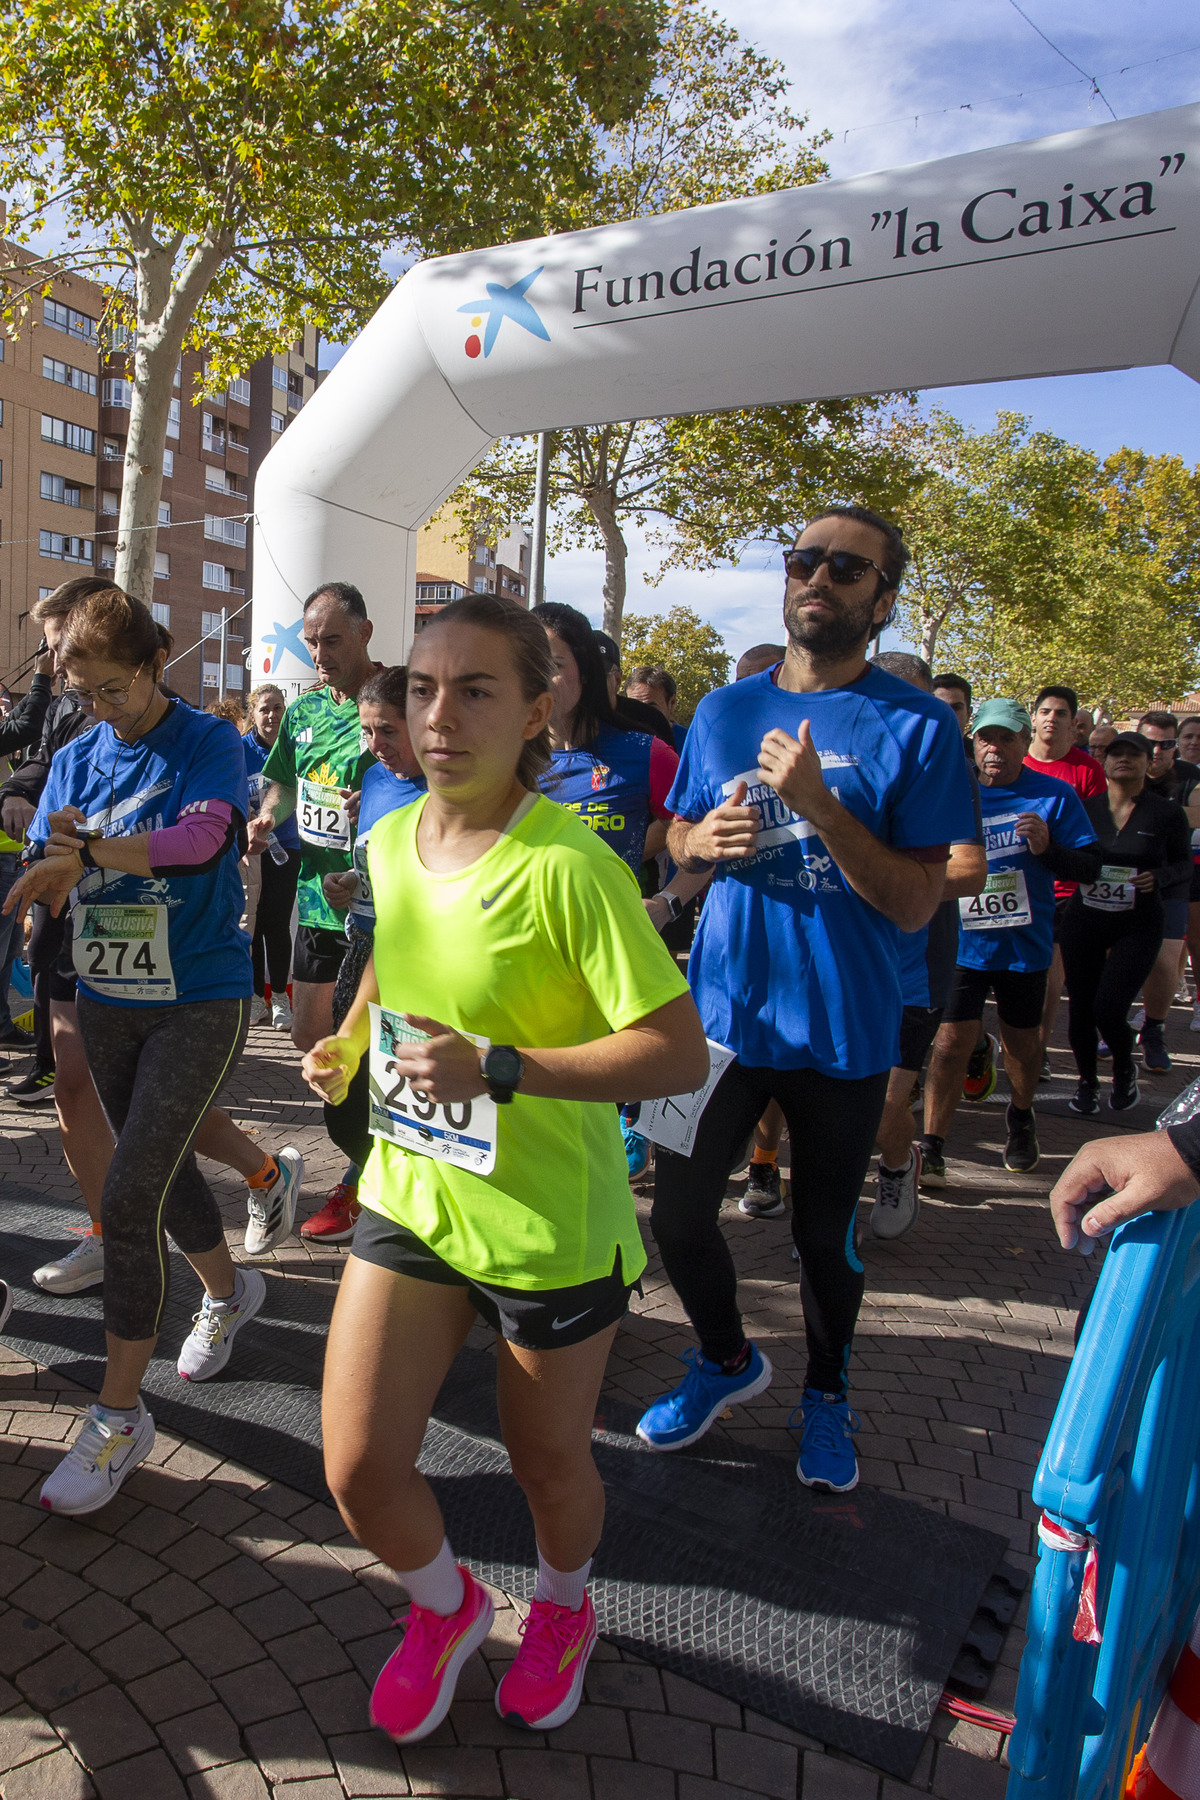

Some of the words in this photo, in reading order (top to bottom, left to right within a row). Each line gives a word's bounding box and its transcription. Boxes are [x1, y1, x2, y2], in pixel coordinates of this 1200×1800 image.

[572, 228, 852, 314] Fundación
[559, 802, 583, 813] AS
[586, 802, 610, 812] DE
[741, 784, 780, 807] ARRE
[302, 803, 340, 834] 512
[359, 872, 371, 899] 5
[1086, 882, 1127, 901] 234
[968, 892, 1019, 916] 466
[99, 916, 156, 931] INCLUSIVA
[85, 941, 157, 976] 274
